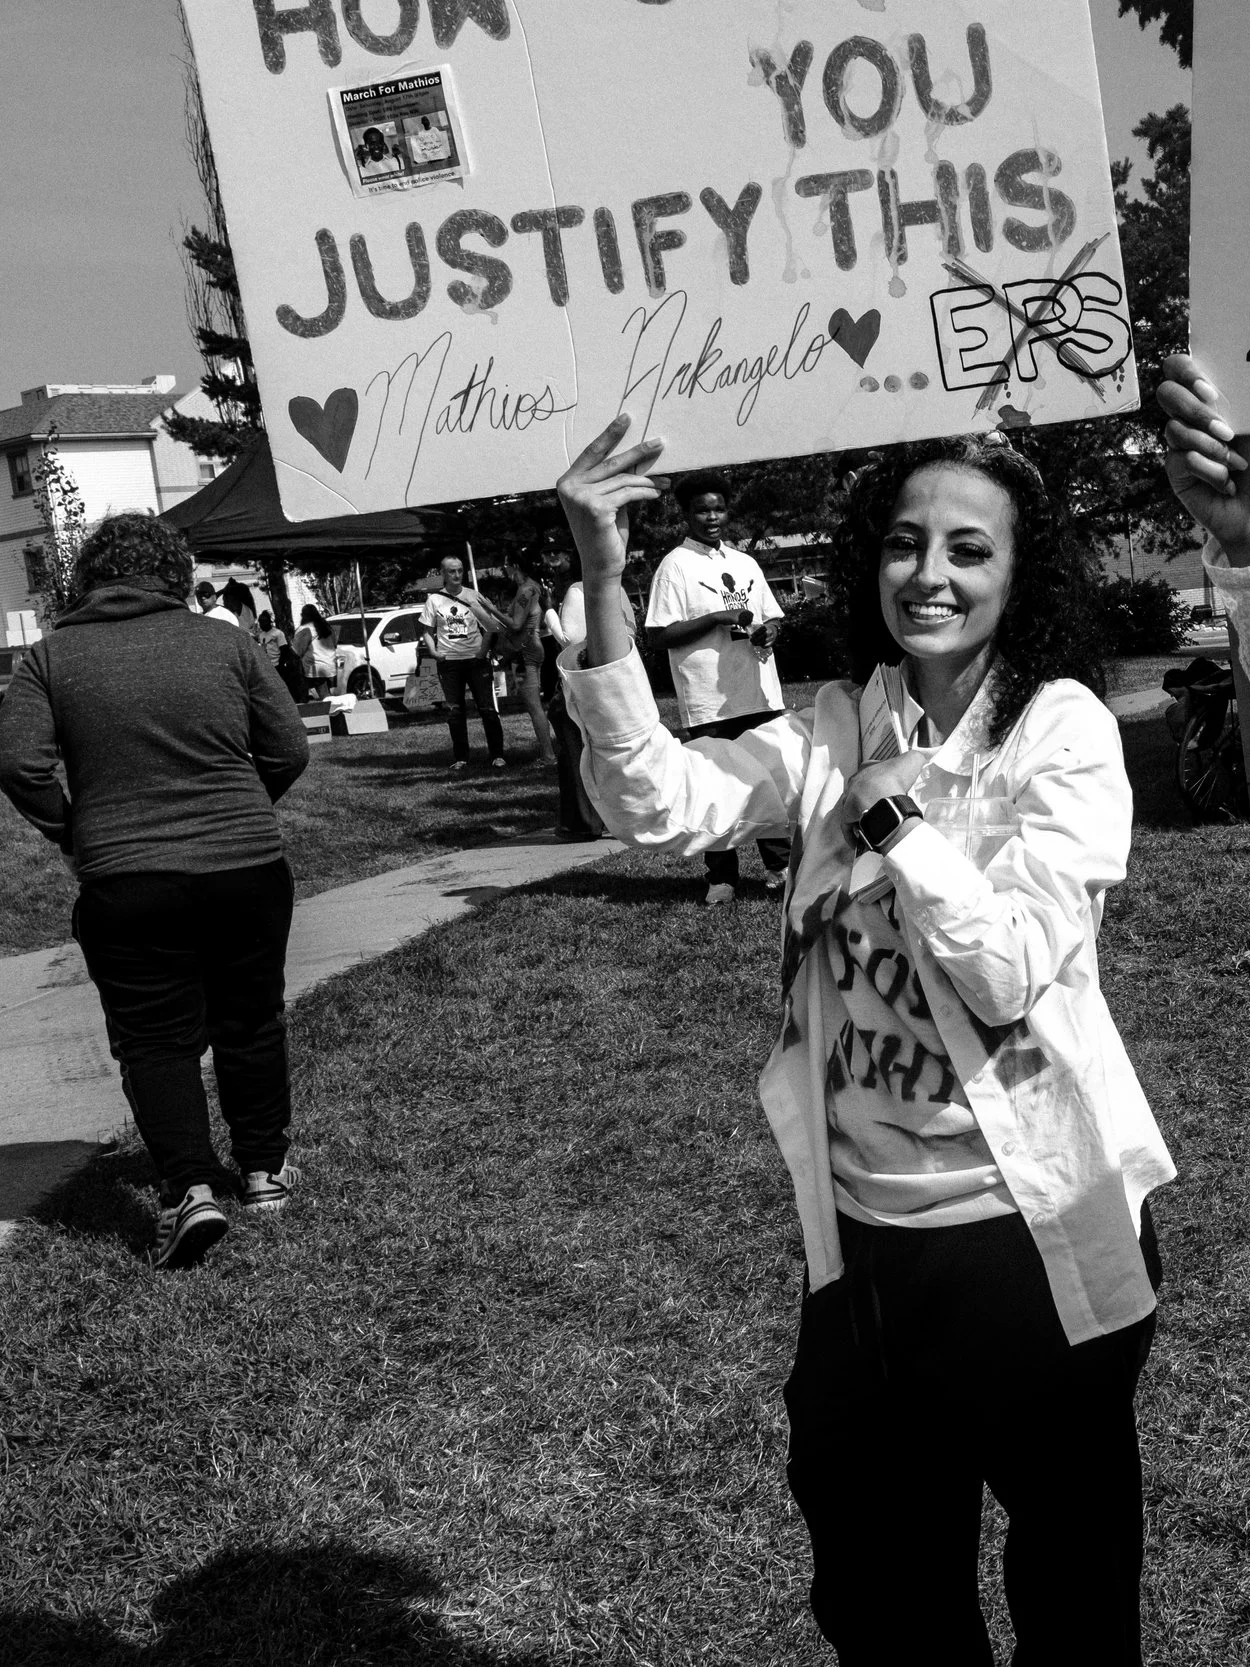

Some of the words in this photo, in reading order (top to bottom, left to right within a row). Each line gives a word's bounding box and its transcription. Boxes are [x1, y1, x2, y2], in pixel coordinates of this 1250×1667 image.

[343, 88, 376, 103] March
[379, 84, 396, 96] For
[398, 76, 440, 92] Mathios
[749, 22, 989, 149] YOU
[275, 182, 763, 338] JUSTIFY
[796, 148, 1077, 271] THIS
[930, 271, 1133, 392] EPS
[364, 331, 578, 507] Mathios
